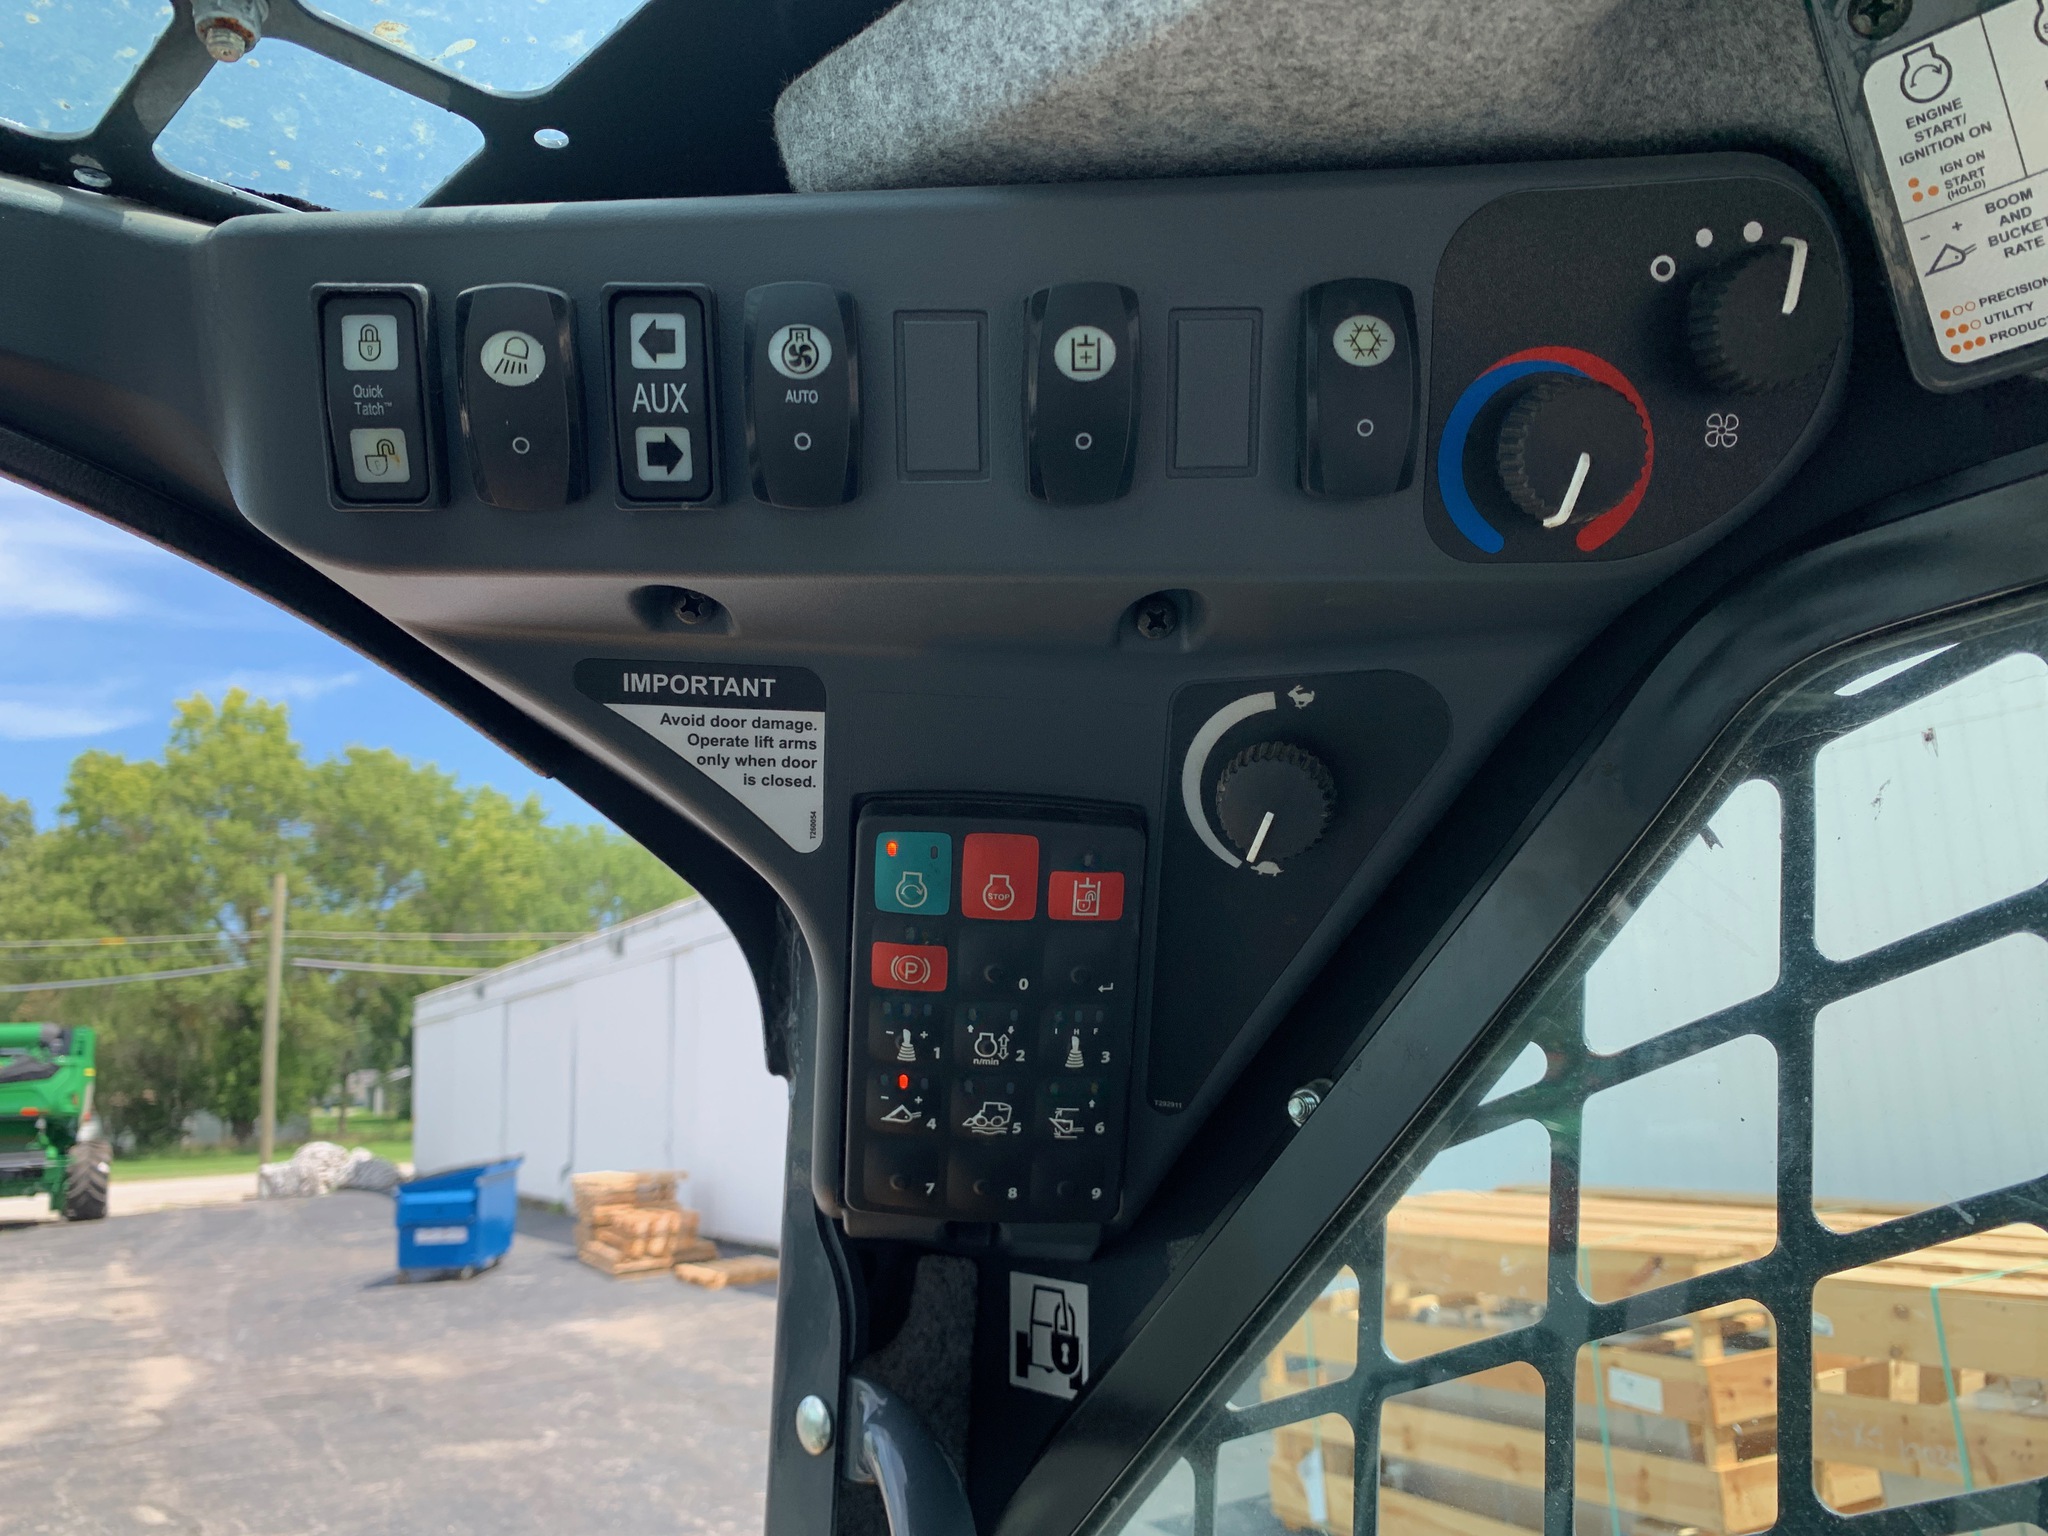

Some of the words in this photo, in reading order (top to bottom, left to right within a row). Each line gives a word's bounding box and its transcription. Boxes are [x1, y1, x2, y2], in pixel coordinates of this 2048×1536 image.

[1906, 97, 1963, 129] ENGINE
[1914, 112, 1967, 142] START/
[1899, 131, 1965, 166] IGNITION
[1968, 121, 1993, 139] ON
[1940, 158, 1963, 175] IGN
[1966, 149, 1985, 165] ON
[1944, 166, 1985, 190] START
[1947, 179, 1986, 201] (HOLD)
[1984, 187, 2033, 214] BOOM
[1999, 206, 2032, 227] AND
[2003, 235, 2045, 258] RATE
[1984, 301, 2034, 326] UTILITY
[1989, 316, 2048, 344] PRODUC
[353, 384, 384, 399] Quick
[632, 383, 689, 414] AUX
[785, 389, 819, 404] AUTO
[623, 672, 776, 698] IMPORTANT
[660, 712, 705, 727] Avoid
[710, 715, 747, 729] door
[751, 716, 818, 733] damage.
[687, 733, 749, 749] Operate
[754, 735, 774, 749] lift
[779, 739, 817, 750] arms
[696, 754, 730, 769] only
[735, 755, 776, 767] when
[781, 756, 818, 769] door
[743, 773, 756, 786] is
[761, 774, 817, 788] closed.
[987, 892, 1010, 901] STOP
[905, 962, 918, 979] P
[1018, 978, 1029, 990] 0
[1073, 1028, 1081, 1036] H
[1093, 1027, 1099, 1035] F
[933, 1047, 941, 1060] 1
[1015, 1050, 1026, 1062] 2
[1101, 1051, 1111, 1063] 3
[973, 1058, 1000, 1066] n/min
[926, 1118, 937, 1130] 4
[1011, 1122, 1022, 1135] 5
[1095, 1121, 1105, 1134] 6
[925, 1183, 936, 1195] 7
[1008, 1187, 1018, 1200] 8
[1091, 1187, 1102, 1200] 9
